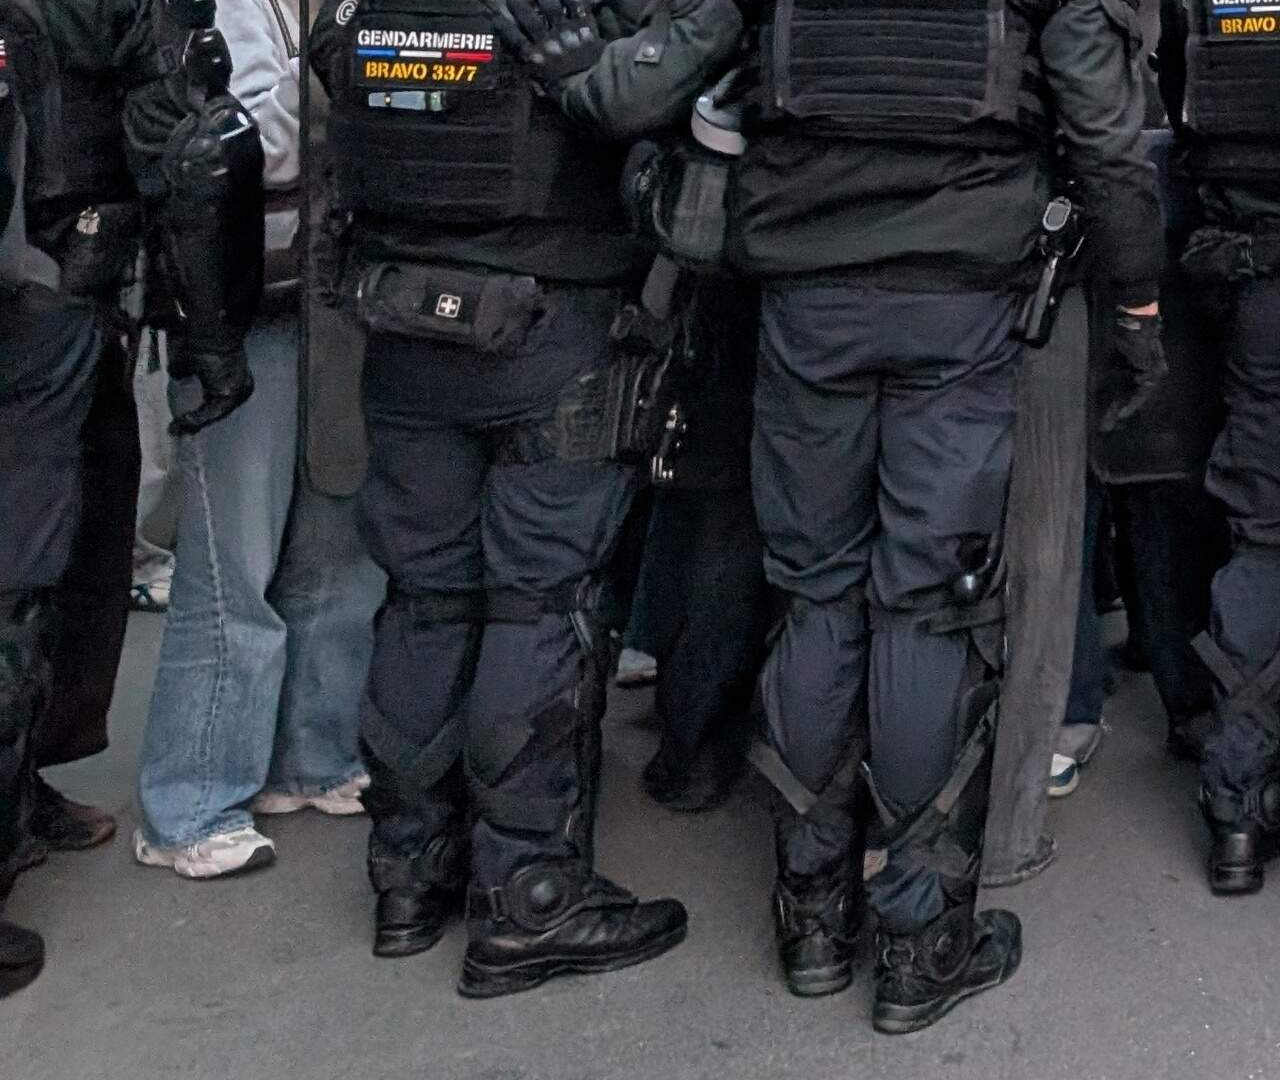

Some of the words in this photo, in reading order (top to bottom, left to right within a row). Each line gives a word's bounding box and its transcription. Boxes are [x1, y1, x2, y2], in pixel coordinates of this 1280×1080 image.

[1221, 17, 1276, 34] BRAVO
[357, 29, 494, 50] GENDARMERIE
[365, 61, 428, 80] BRAVO
[432, 64, 478, 82] 33/7
